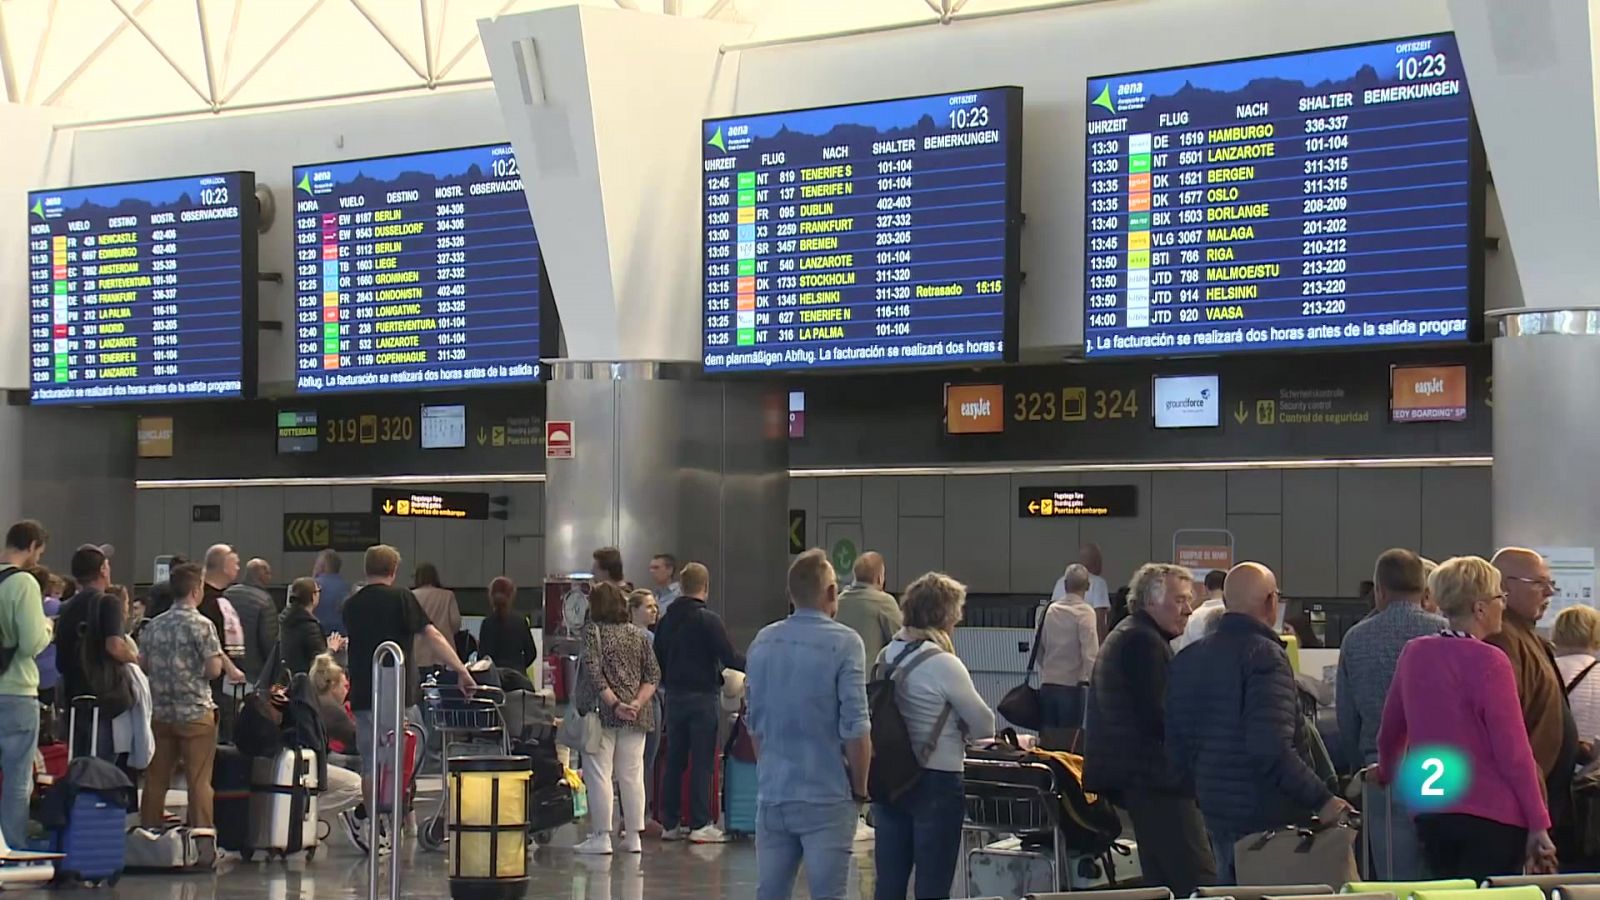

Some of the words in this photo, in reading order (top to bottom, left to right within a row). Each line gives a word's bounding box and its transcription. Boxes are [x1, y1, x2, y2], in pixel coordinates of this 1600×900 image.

[1396, 40, 1431, 52] ORTSZEIT
[1396, 54, 1446, 80] 10:23
[949, 94, 977, 105] ORTSZEIT
[1118, 82, 1143, 95] aena
[949, 106, 988, 129] 10:23
[1088, 118, 1128, 134] UHRZEIT
[1160, 111, 1188, 127] FLUG
[1236, 102, 1268, 118] NACH
[1299, 92, 1353, 111] SHALTER
[1364, 80, 1459, 104] BEMERKUNGEN
[728, 125, 748, 136] aena
[1092, 140, 1118, 155] 13:30
[1154, 135, 1168, 149] DE
[1180, 131, 1204, 146] 1519
[1208, 124, 1274, 143] HAMBURGO
[1305, 115, 1348, 133] 336-337
[704, 157, 736, 171] UHRZEIT
[762, 152, 785, 165] FLUG
[823, 146, 848, 160] NACH
[872, 139, 916, 154] SHALTER
[924, 130, 998, 150] BEMERKUNGEN
[492, 158, 520, 176] 10:2
[708, 176, 730, 190] 12:45
[757, 172, 769, 185] NT
[800, 166, 844, 181] TENERIFE
[845, 165, 852, 177] S
[878, 159, 912, 174] 101-104
[1092, 179, 1118, 194] 13:35
[1153, 174, 1169, 188] DK
[1179, 171, 1202, 185] 1521
[1208, 166, 1254, 183] BERGEN
[1304, 156, 1348, 174] 311-315
[200, 187, 228, 205] 10:23
[298, 200, 318, 212] HORA
[339, 195, 364, 208] VUELO
[386, 190, 419, 204] DESTINO
[435, 185, 464, 198] MOSTR.
[180, 207, 238, 222] OBSERVACIONES
[1091, 216, 1118, 230] 13:40
[1153, 212, 1170, 226] BIX
[1178, 209, 1203, 224] 1503
[1207, 204, 1269, 221] BORLANGE
[1304, 196, 1347, 213] 208-209
[708, 229, 729, 242] 13:00
[757, 226, 768, 238] X3
[800, 218, 854, 234] FRANKFURT
[876, 213, 911, 228] 327-332
[1091, 236, 1118, 250] 13:45
[1152, 232, 1174, 246] VLG
[1178, 230, 1202, 244] 3067
[1207, 226, 1254, 242] MALAGA
[1303, 218, 1347, 234] 201-202
[298, 249, 316, 260] 12:20
[339, 246, 350, 257] EC
[374, 242, 402, 254] BERLIN
[298, 264, 316, 276] 12:20
[375, 257, 397, 269] LIEGE
[1090, 275, 1117, 288] 13:50
[1152, 271, 1172, 285] JTD
[1180, 269, 1199, 283] 798
[1206, 264, 1279, 281] MALMOE/STU
[1302, 259, 1346, 275] 213-220
[708, 281, 729, 293] 13:15
[756, 278, 769, 290] DK
[777, 276, 796, 288] 1733
[799, 272, 855, 287] STOCKHOLM
[876, 268, 910, 282] 311-320
[708, 298, 729, 310] 13:15
[756, 296, 769, 308] DK
[777, 294, 796, 306] 1345
[800, 291, 840, 305] HELSINKI
[876, 286, 910, 300] 311-320
[916, 283, 962, 297] Retrasado
[976, 280, 1002, 294] 15:15
[299, 342, 317, 353] 12:40
[376, 336, 419, 348] LANZAROTE
[438, 332, 466, 344] 101-104
[1097, 336, 1111, 349] La
[1113, 332, 1174, 348] facturación
[1177, 334, 1191, 345] se
[1194, 328, 1243, 344] realizará
[1246, 328, 1268, 342] dos
[1270, 327, 1304, 340] horas
[1307, 324, 1341, 339] antes
[1344, 323, 1360, 337] de
[1363, 322, 1375, 336] la
[1378, 320, 1416, 335] salida
[299, 358, 317, 369] 12:40
[340, 356, 351, 367] DK
[376, 351, 426, 364] COPENHAGUE
[438, 348, 466, 361] 311-320
[704, 353, 724, 366] dem
[784, 349, 816, 364] Abflug.
[819, 348, 831, 360] La
[833, 344, 885, 360] facturación
[887, 346, 899, 357] se
[901, 341, 943, 356] realizará
[945, 341, 964, 354] dos
[966, 340, 995, 353] horas
[1414, 377, 1444, 396] easyJet
[960, 397, 990, 420] easyJet
[1014, 393, 1055, 421] 323
[1094, 389, 1138, 419] 324
[1166, 397, 1204, 410] groundforce
[326, 419, 357, 443] 319
[381, 416, 412, 440] 320
[1280, 412, 1312, 422] Control
[1313, 412, 1324, 422] de
[1325, 411, 1368, 424] seguridad
